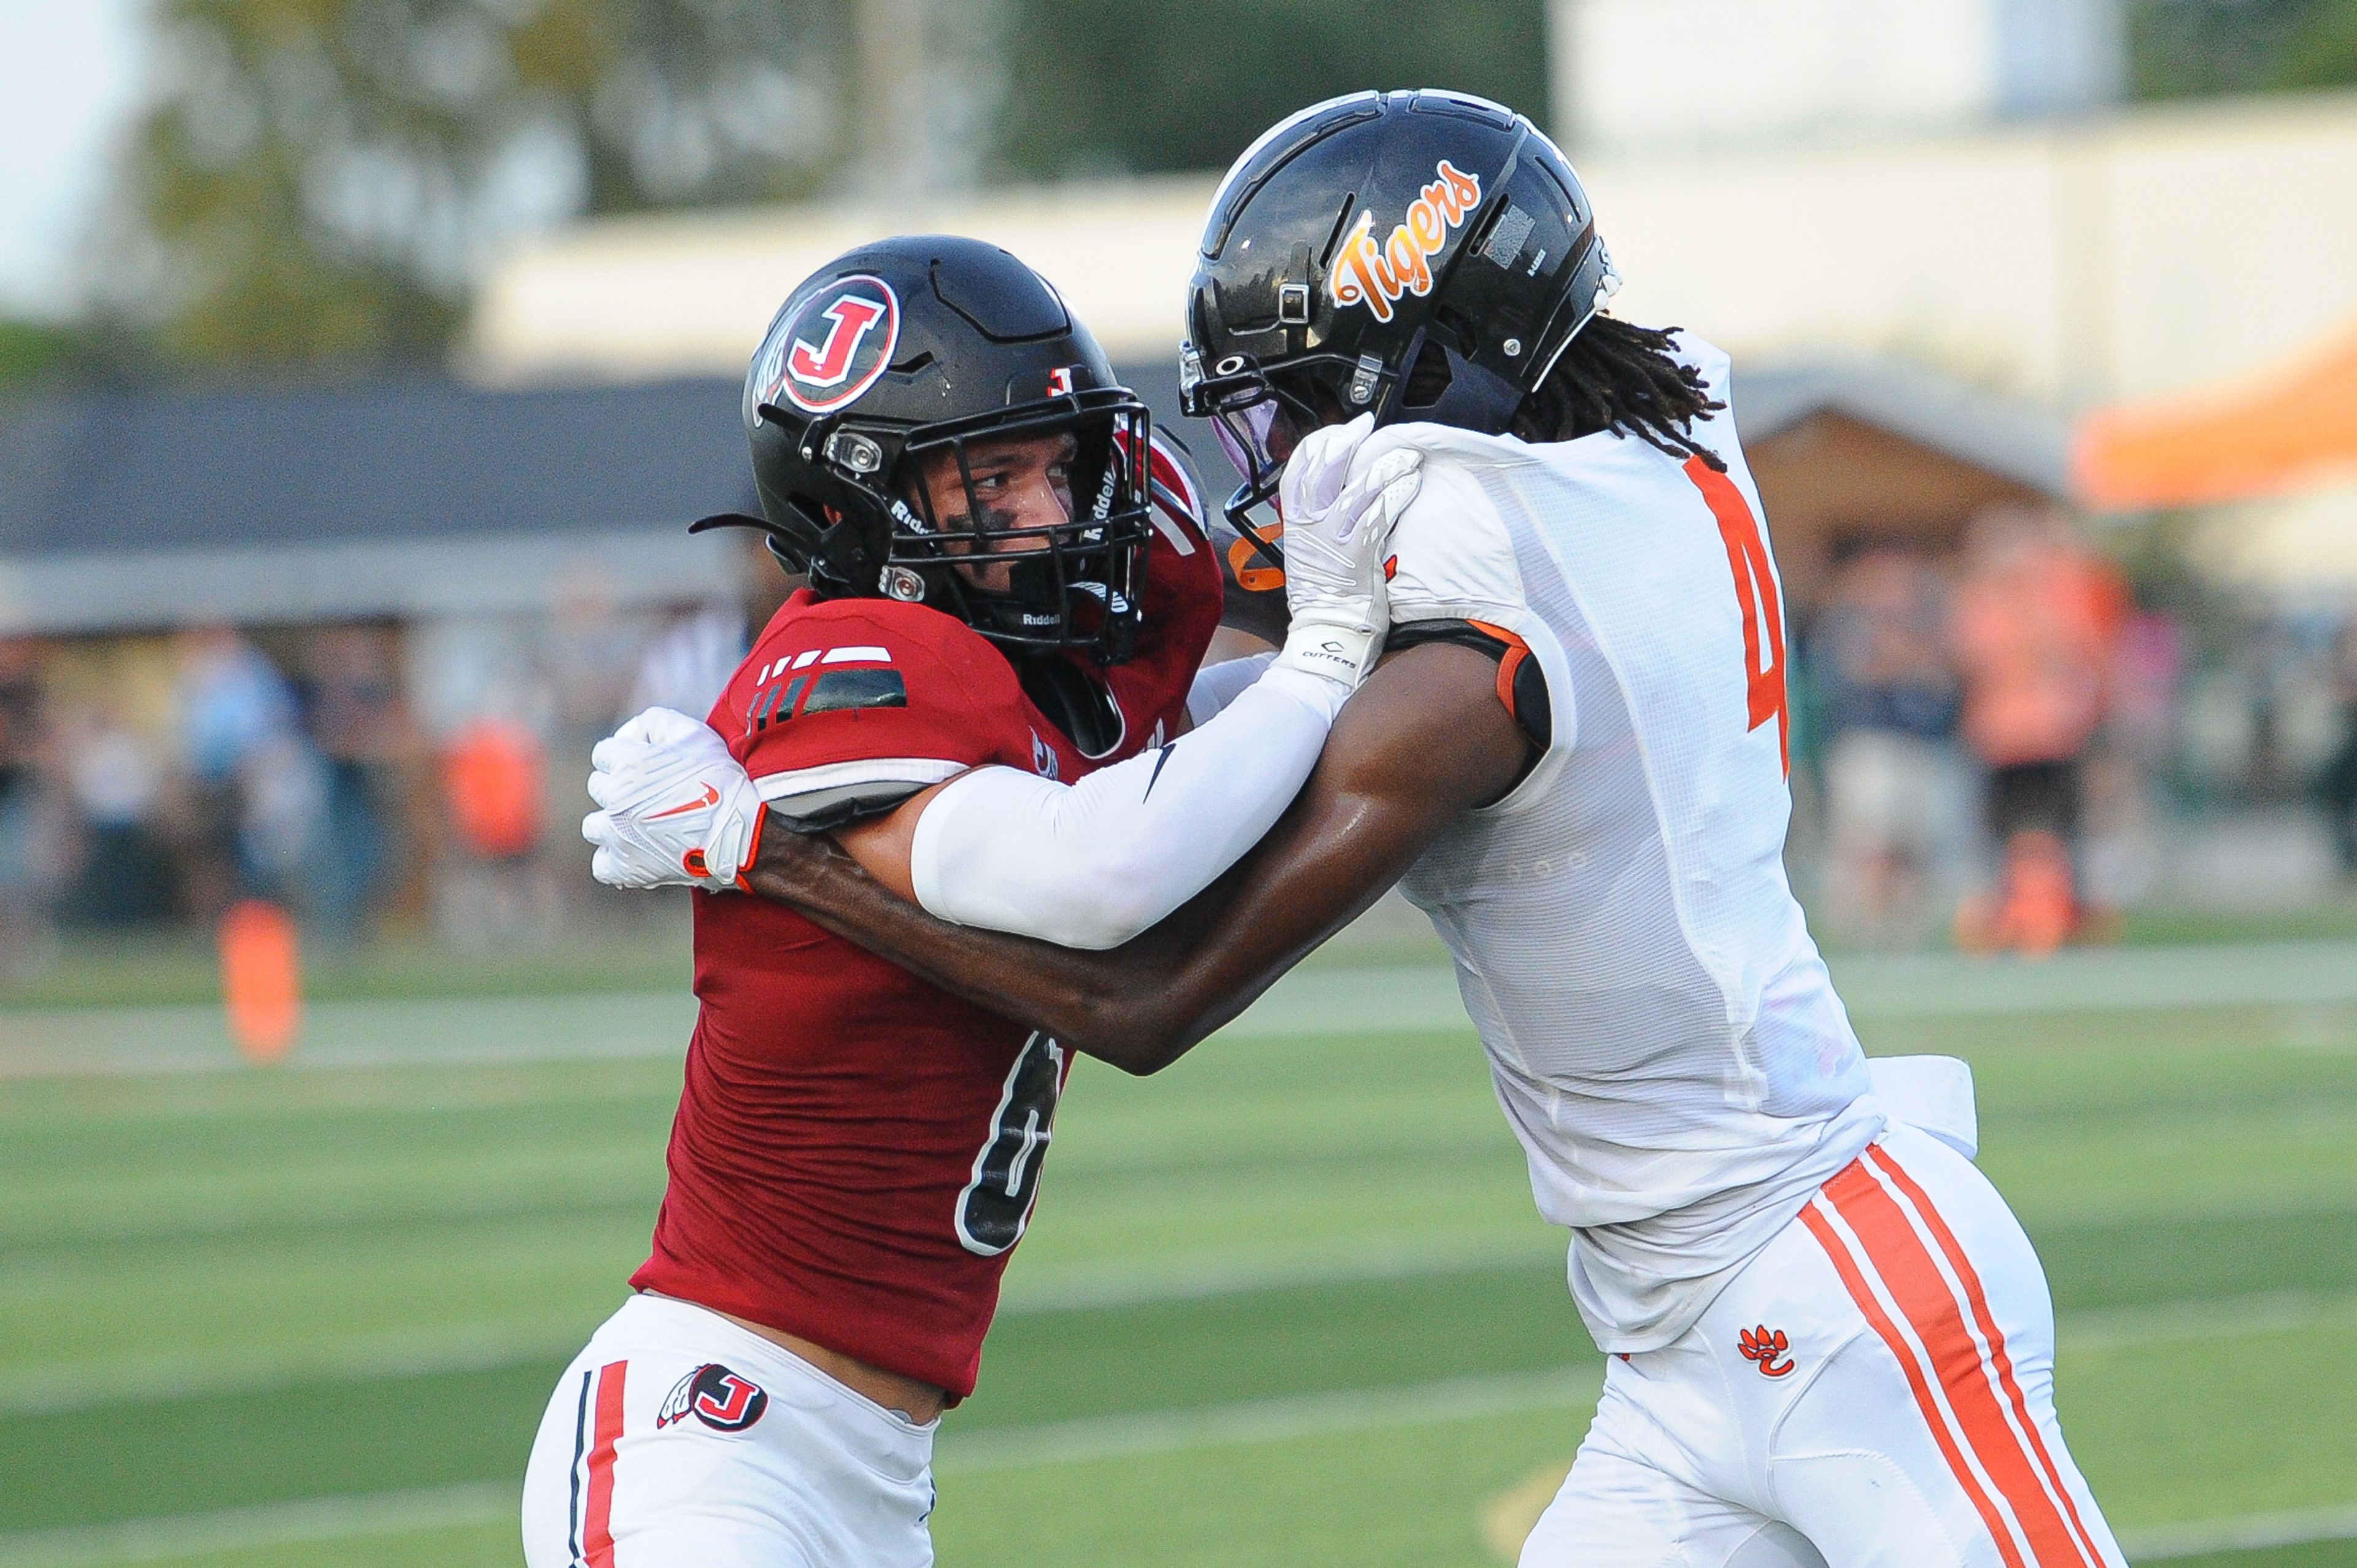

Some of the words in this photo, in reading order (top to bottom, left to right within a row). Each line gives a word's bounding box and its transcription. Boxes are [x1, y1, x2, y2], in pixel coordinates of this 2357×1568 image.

[1329, 159, 1482, 323] Tigers
[787, 294, 887, 388] J
[1047, 367, 1073, 398] J
[1083, 471, 1116, 541] Rddell
[1023, 614, 1061, 625] Riddell
[1682, 453, 1790, 785] 4
[1302, 651, 1357, 669] CUTTERS
[694, 1373, 761, 1424] J
